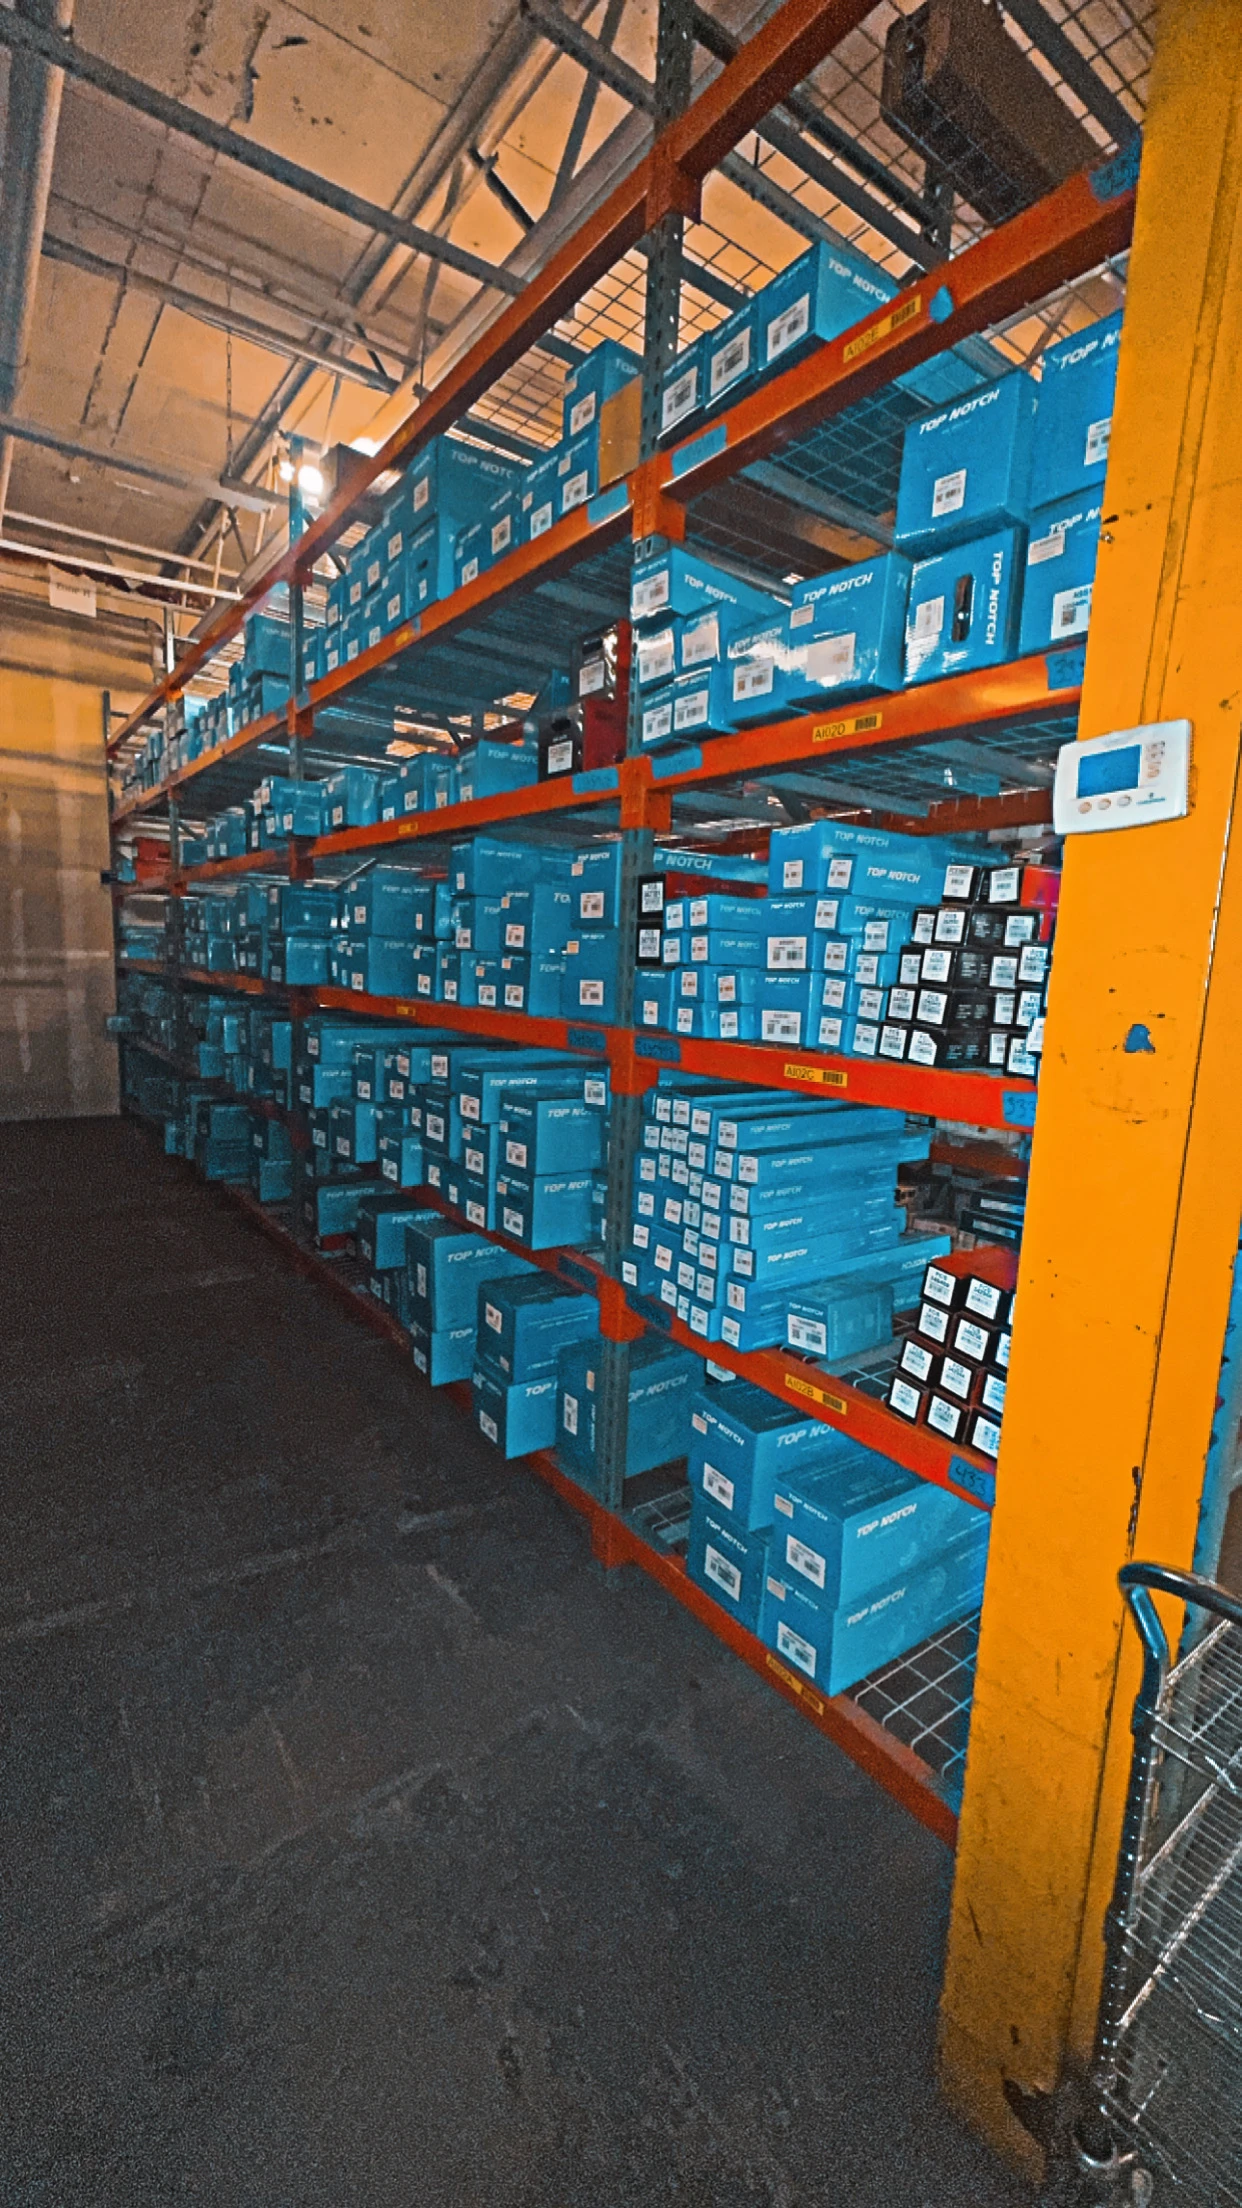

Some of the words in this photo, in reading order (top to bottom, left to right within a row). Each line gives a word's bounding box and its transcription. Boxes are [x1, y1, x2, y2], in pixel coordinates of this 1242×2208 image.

[829, 258, 852, 277] TOP
[853, 276, 890, 303] NOTCH
[1060, 340, 1098, 370] TOP
[919, 414, 947, 435] TOP
[948, 389, 1000, 421] NOTCH
[451, 450, 478, 465] TOP
[479, 461, 514, 479] NOTC
[992, 551, 1003, 586] TOP
[684, 574, 704, 590] TOP
[705, 583, 737, 604] NOTCH
[803, 588, 827, 604] TOP
[828, 572, 874, 596] NOTCH
[985, 589, 1000, 645] NOTCH
[487, 749, 509, 760] TOP
[510, 753, 538, 764] NOTC
[834, 830, 854, 842] TOP
[856, 833, 889, 848] NOTCH
[666, 854, 712, 870] NOTCH
[866, 866, 886, 878] TOP
[887, 870, 920, 884] NOTCH
[719, 904, 736, 914] TOP
[784, 901, 806, 910] NOTCH
[854, 905, 875, 916] TOP
[877, 907, 909, 920] NOTCH
[720, 940, 735, 949] TOP
[736, 940, 759, 949] NOTC
[765, 977, 778, 985] TOP
[489, 1079, 507, 1087] TOP
[508, 1077, 538, 1085] NOTCH
[548, 1108, 570, 1118] TOP
[750, 1124, 765, 1133] TOP
[765, 1123, 792, 1132] NOTCH
[771, 1159, 787, 1168] TOP
[787, 1156, 814, 1166] NOTCH
[544, 1184, 566, 1193] TOP
[568, 1180, 592, 1191] NOT
[759, 1190, 775, 1199] TOP
[775, 1186, 802, 1197] NOTCH
[763, 1222, 778, 1231] TOP
[778, 1217, 803, 1228] NOTCH
[448, 1250, 473, 1263] TOP
[474, 1245, 506, 1257] NOT
[767, 1254, 782, 1263] TOP
[783, 1248, 808, 1260] NOTCH
[789, 1302, 802, 1310] TOP
[802, 1305, 824, 1317] NOTCH
[449, 1328, 473, 1340] TOP
[525, 1383, 552, 1397] TOP
[646, 1374, 689, 1396] NOTCH
[702, 1410, 717, 1425] TOP
[717, 1423, 745, 1447] NOTCH
[776, 1428, 808, 1448] TOP
[788, 1493, 802, 1504] TOP
[803, 1501, 828, 1522] NOTCH
[856, 1520, 879, 1538] TOP
[880, 1503, 917, 1528] NOTCH
[705, 1516, 721, 1532] TOP
[721, 1528, 748, 1554] NOTCH
[793, 1588, 819, 1610] NOTCH
[847, 1608, 869, 1627] TOP
[870, 1588, 905, 1613] NOTCH
